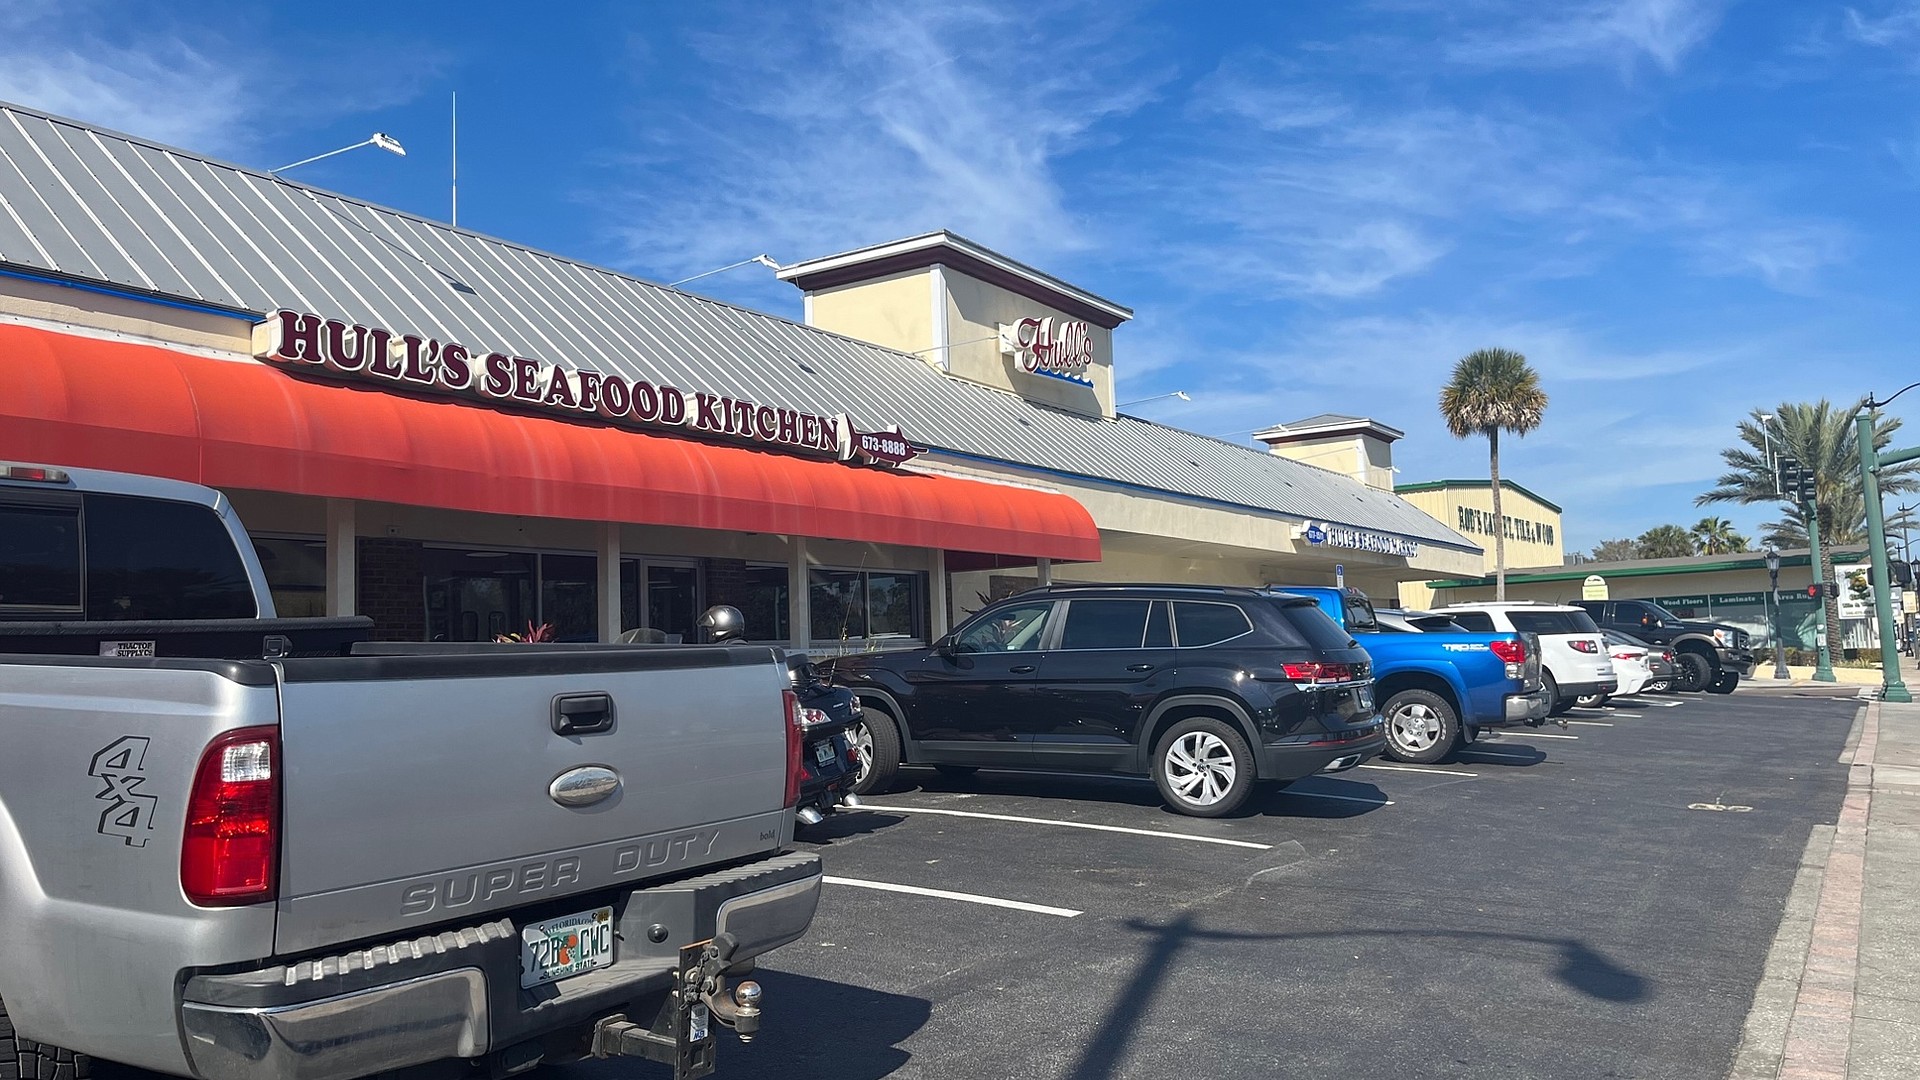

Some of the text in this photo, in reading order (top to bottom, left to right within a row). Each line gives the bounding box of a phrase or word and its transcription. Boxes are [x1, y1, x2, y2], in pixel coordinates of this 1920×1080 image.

[1017, 317, 1093, 373] Hull's
[278, 310, 839, 450] HULL'S SEAFOOD KITCHEN
[861, 434, 906, 456] 673-8888
[1514, 518, 1531, 543] TILE
[1535, 522, 1554, 546] WOOD
[1662, 598, 1703, 606] Wood Floors
[1719, 596, 1756, 604] Laminate
[117, 649, 144, 657] SUPPLY
[1441, 643, 1469, 652] TRD
[400, 829, 720, 918] SUPER DUTY
[580, 924, 610, 960] CWC
[575, 958, 594, 971] STATE
